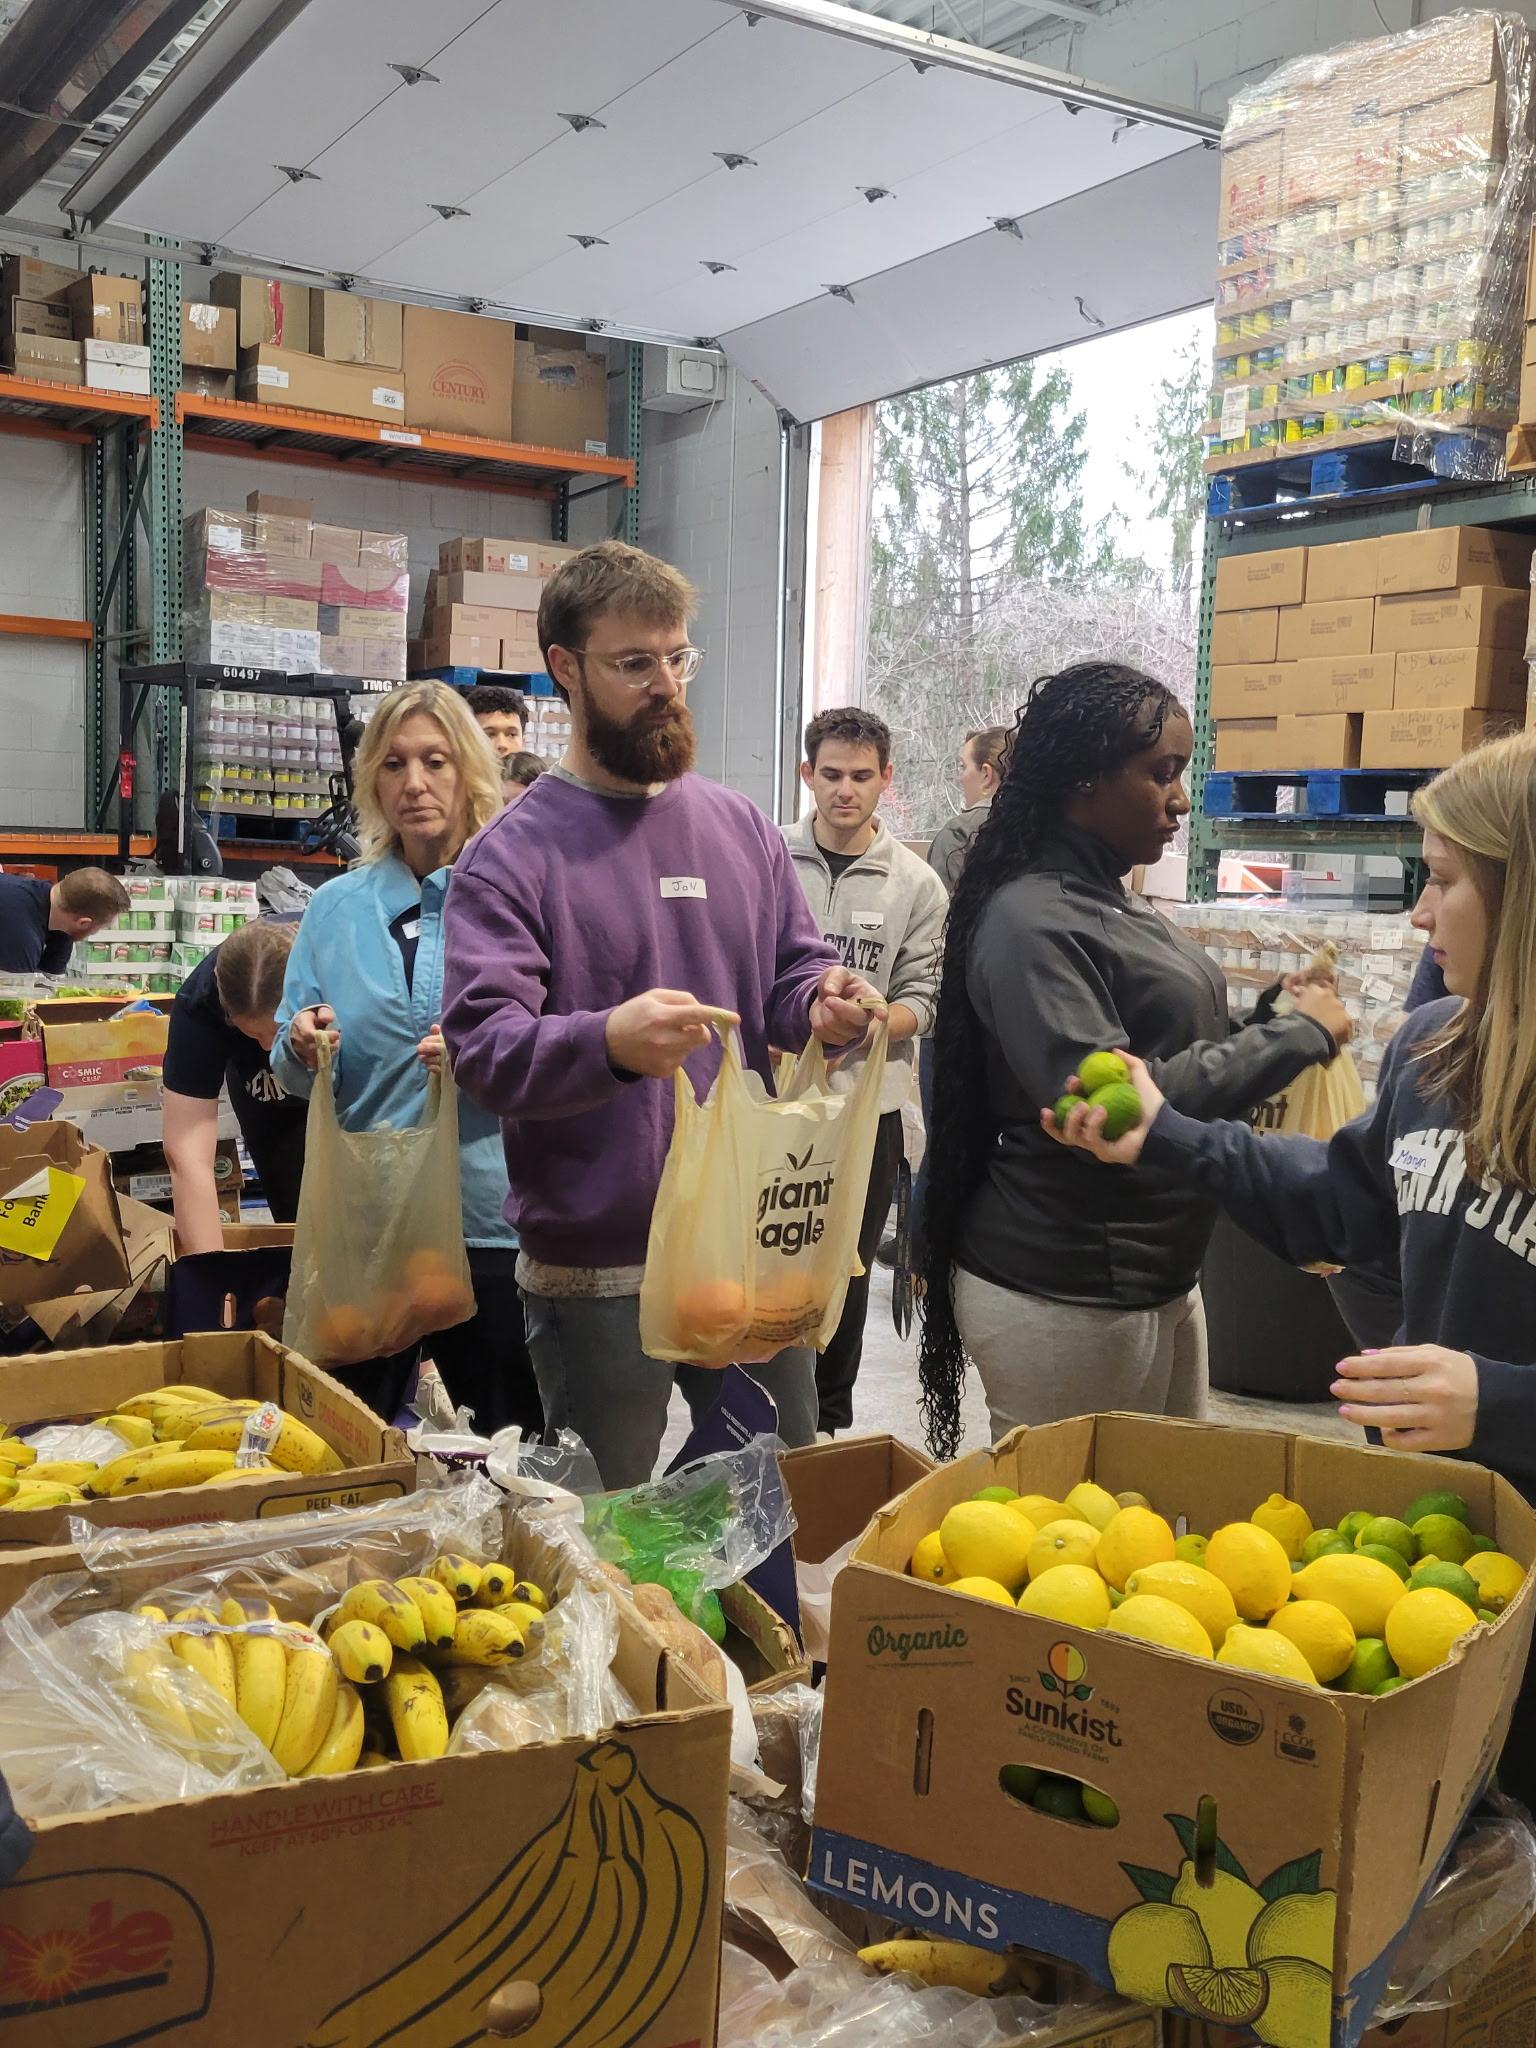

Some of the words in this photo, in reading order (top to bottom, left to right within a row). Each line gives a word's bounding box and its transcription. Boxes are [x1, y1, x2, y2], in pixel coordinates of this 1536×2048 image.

[432, 380, 486, 399] CENTURY
[223, 667, 261, 681] 60497
[361, 679, 392, 692] TMG
[62, 1066, 102, 1079] COSMIC
[757, 1171, 834, 1224] giant
[755, 1211, 825, 1256] agle
[867, 1623, 969, 1661] Organic
[1005, 1686, 1123, 1748] Sunkist
[211, 1803, 307, 1840] HANDLE
[312, 1793, 374, 1820] WITH
[379, 1782, 436, 1809] CARE
[350, 1820, 375, 1837] OR
[823, 1850, 999, 1939] LEMONS
